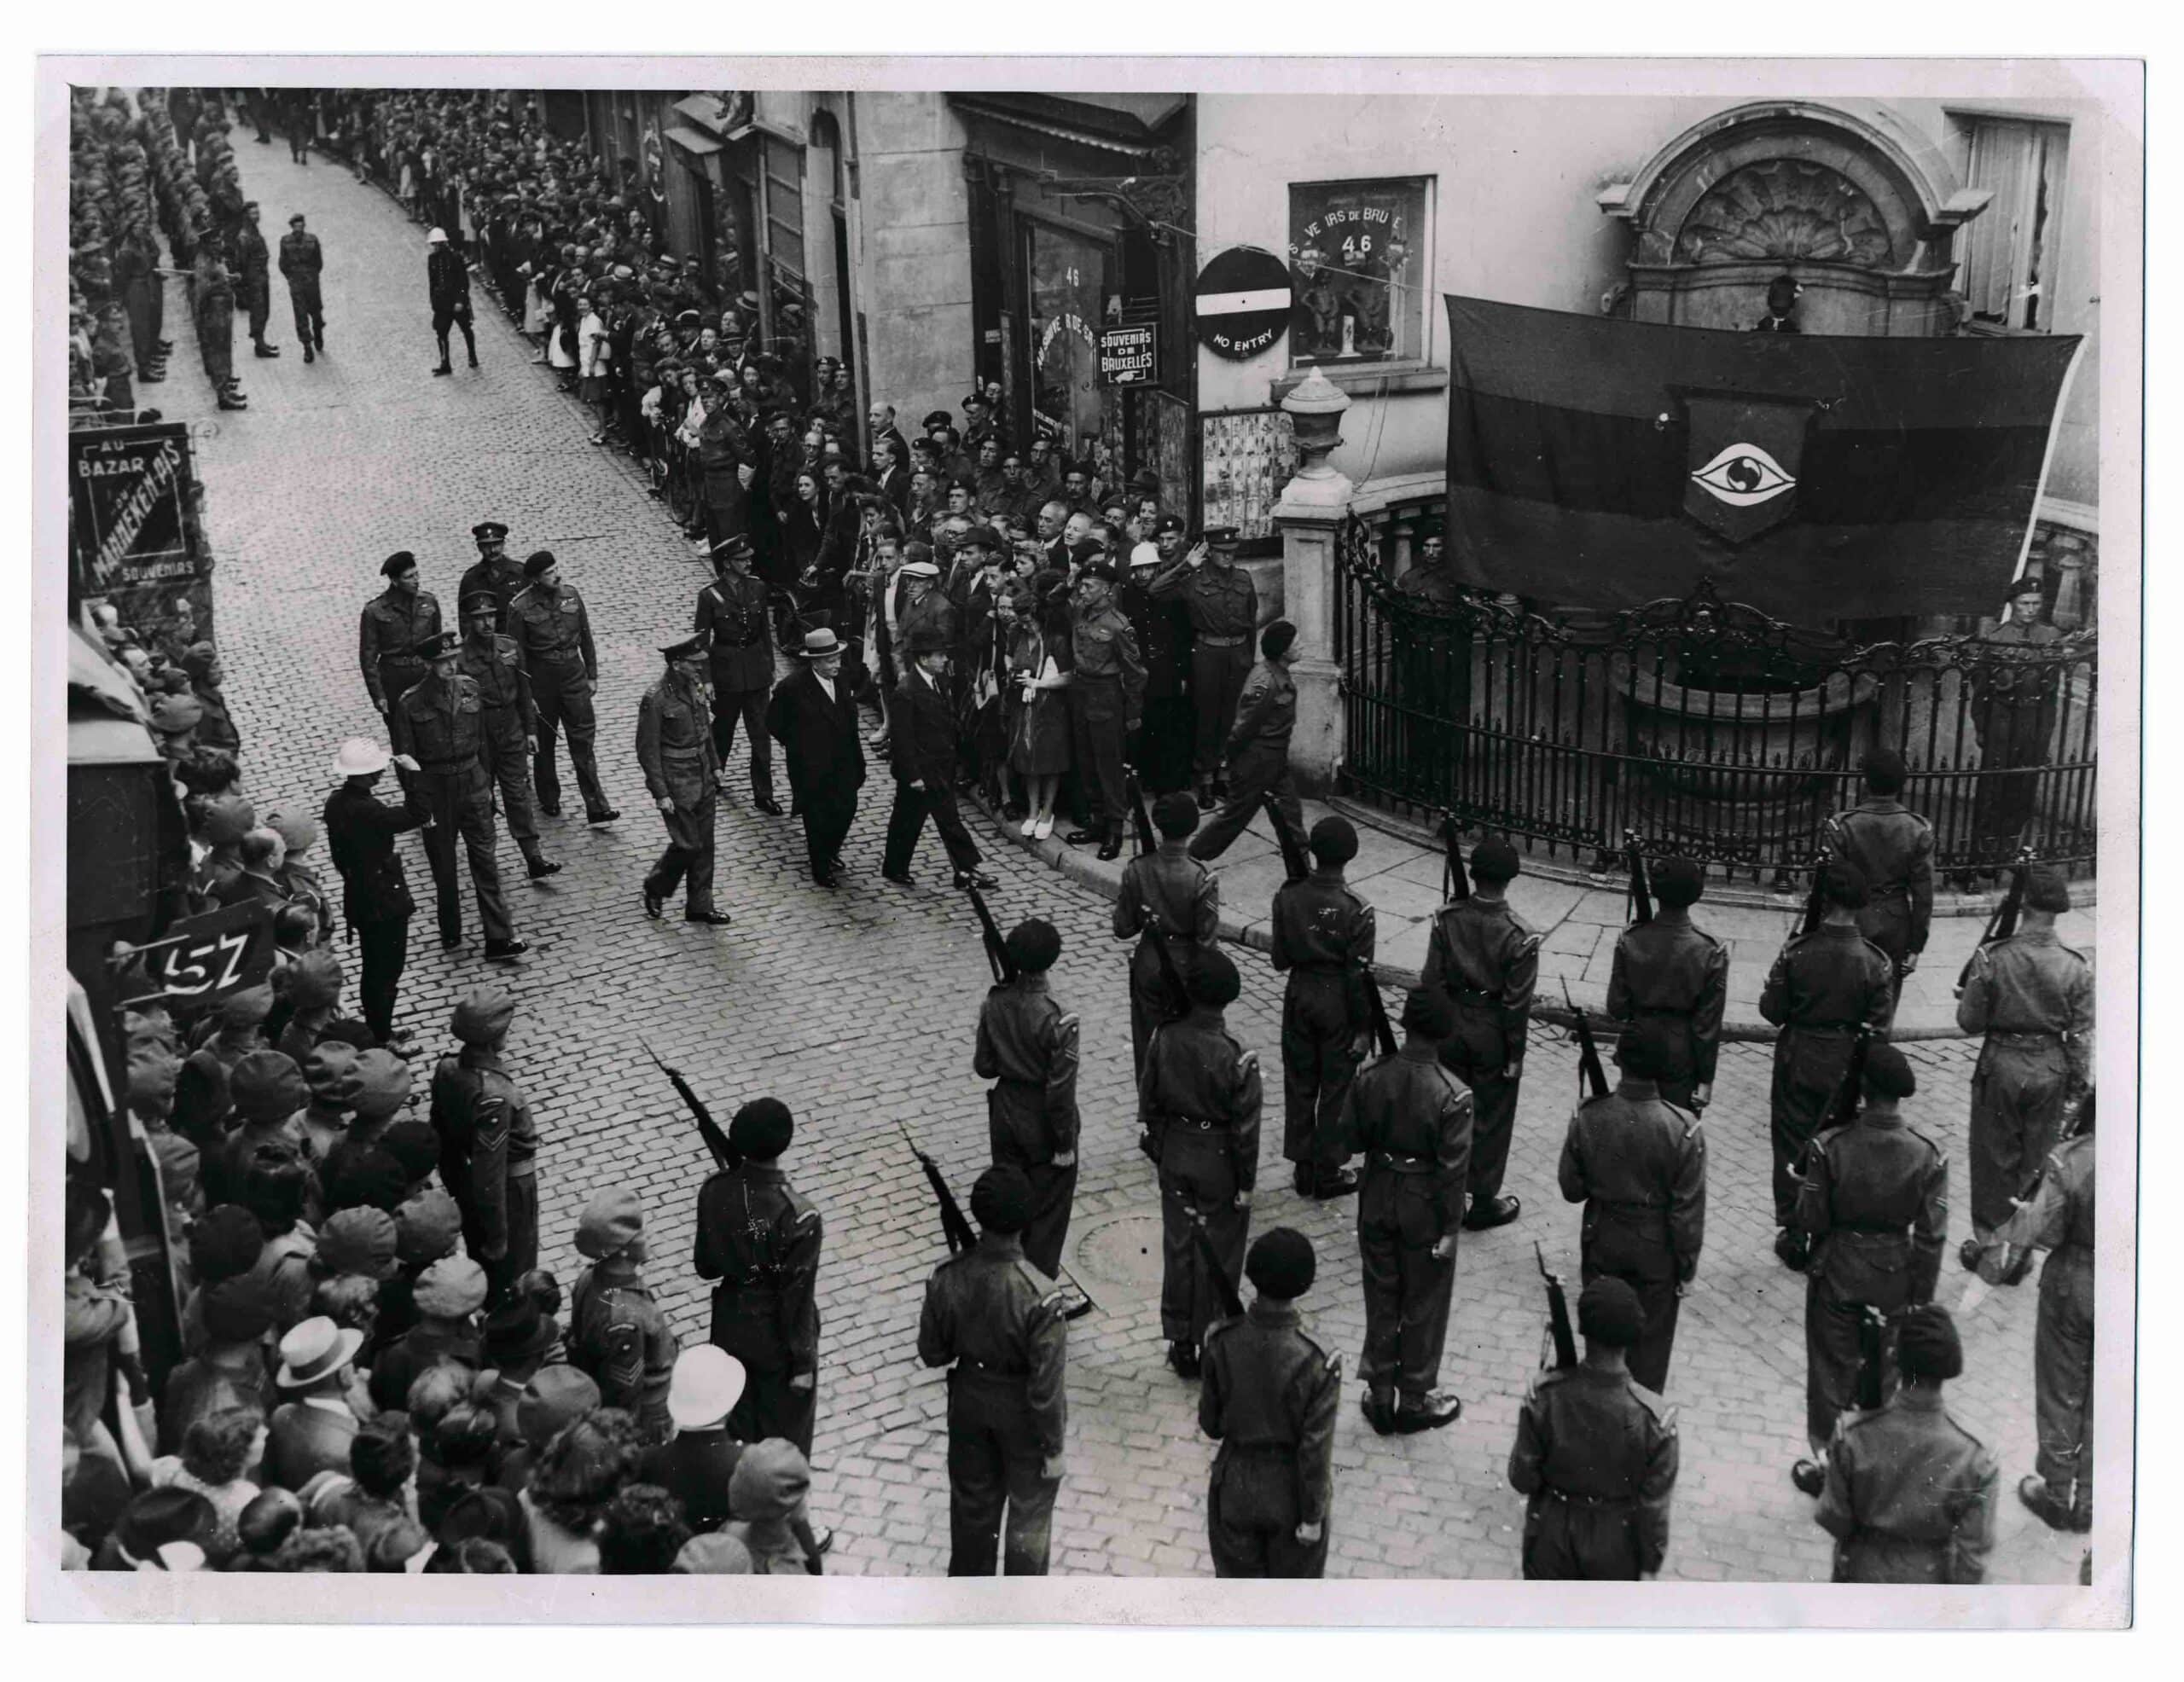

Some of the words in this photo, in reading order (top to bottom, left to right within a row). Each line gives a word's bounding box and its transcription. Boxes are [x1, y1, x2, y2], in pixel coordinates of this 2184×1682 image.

[1066, 265, 1079, 287] 46
[1101, 332, 1152, 348] SOUVENIRS
[1213, 334, 1230, 348] NO
[1234, 328, 1272, 351] ENTRY
[1118, 346, 1136, 356] DE
[1101, 351, 1153, 373] BRUXELLES
[100, 440, 124, 452] AU
[78, 457, 145, 477] BAZAR
[122, 561, 194, 581] SOUVENIRS
